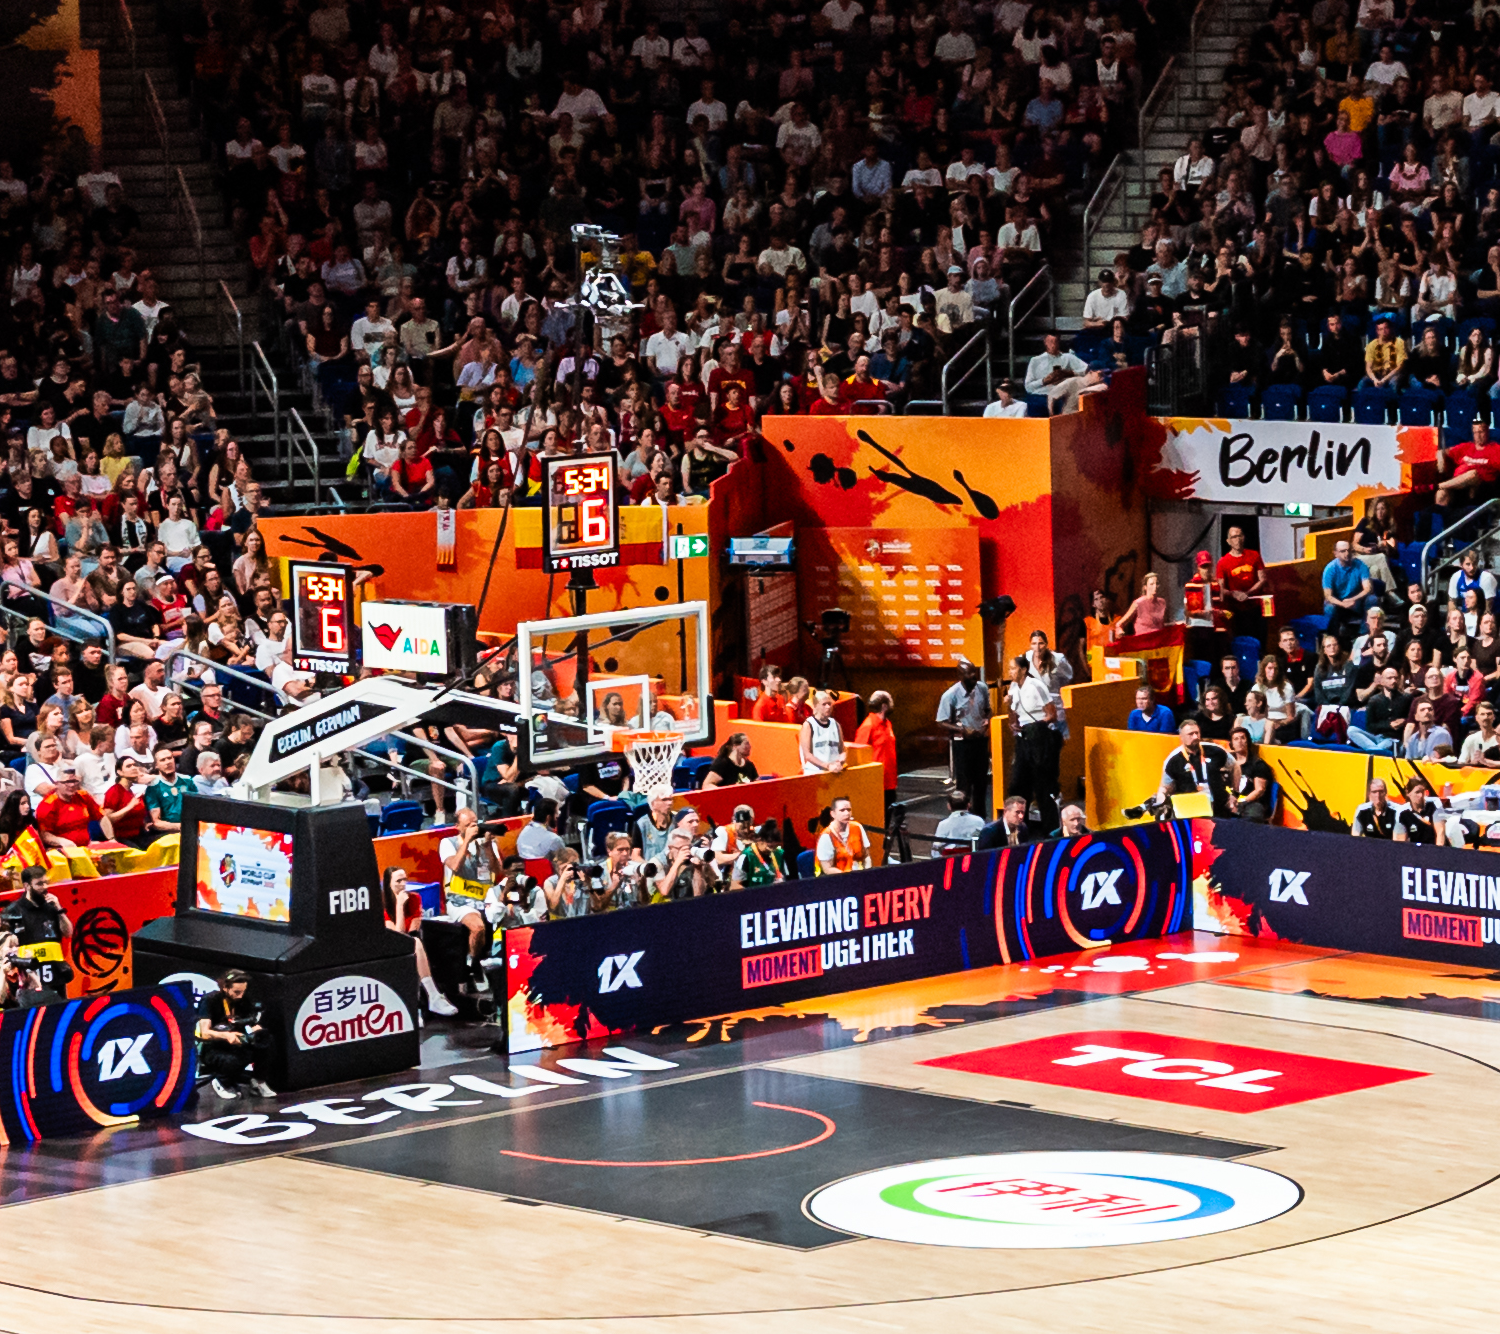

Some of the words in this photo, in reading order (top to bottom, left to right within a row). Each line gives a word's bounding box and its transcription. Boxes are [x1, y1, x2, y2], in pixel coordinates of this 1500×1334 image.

[1219, 430, 1371, 487] Berlin
[564, 467, 609, 495] 5:34
[581, 499, 606, 543] 6
[569, 552, 618, 569] TISSOT
[306, 576, 345, 601] 5:34
[321, 608, 344, 651] 6
[403, 637, 441, 657] AIDA
[308, 659, 349, 674] TISSOT
[329, 886, 370, 915] FIBA
[1081, 868, 1124, 910] 1X
[1268, 867, 1311, 906] 1X
[741, 896, 859, 949] ELEVATING
[863, 884, 934, 928] EVERY
[1408, 911, 1478, 943] MOMENT
[598, 950, 645, 993] 1X
[746, 950, 818, 983] MOMENT
[314, 983, 379, 1013] 百岁山
[97, 1033, 154, 1082] 1X
[1051, 1044, 1284, 1093] TCL
[180, 1047, 679, 1145] BERLIN
